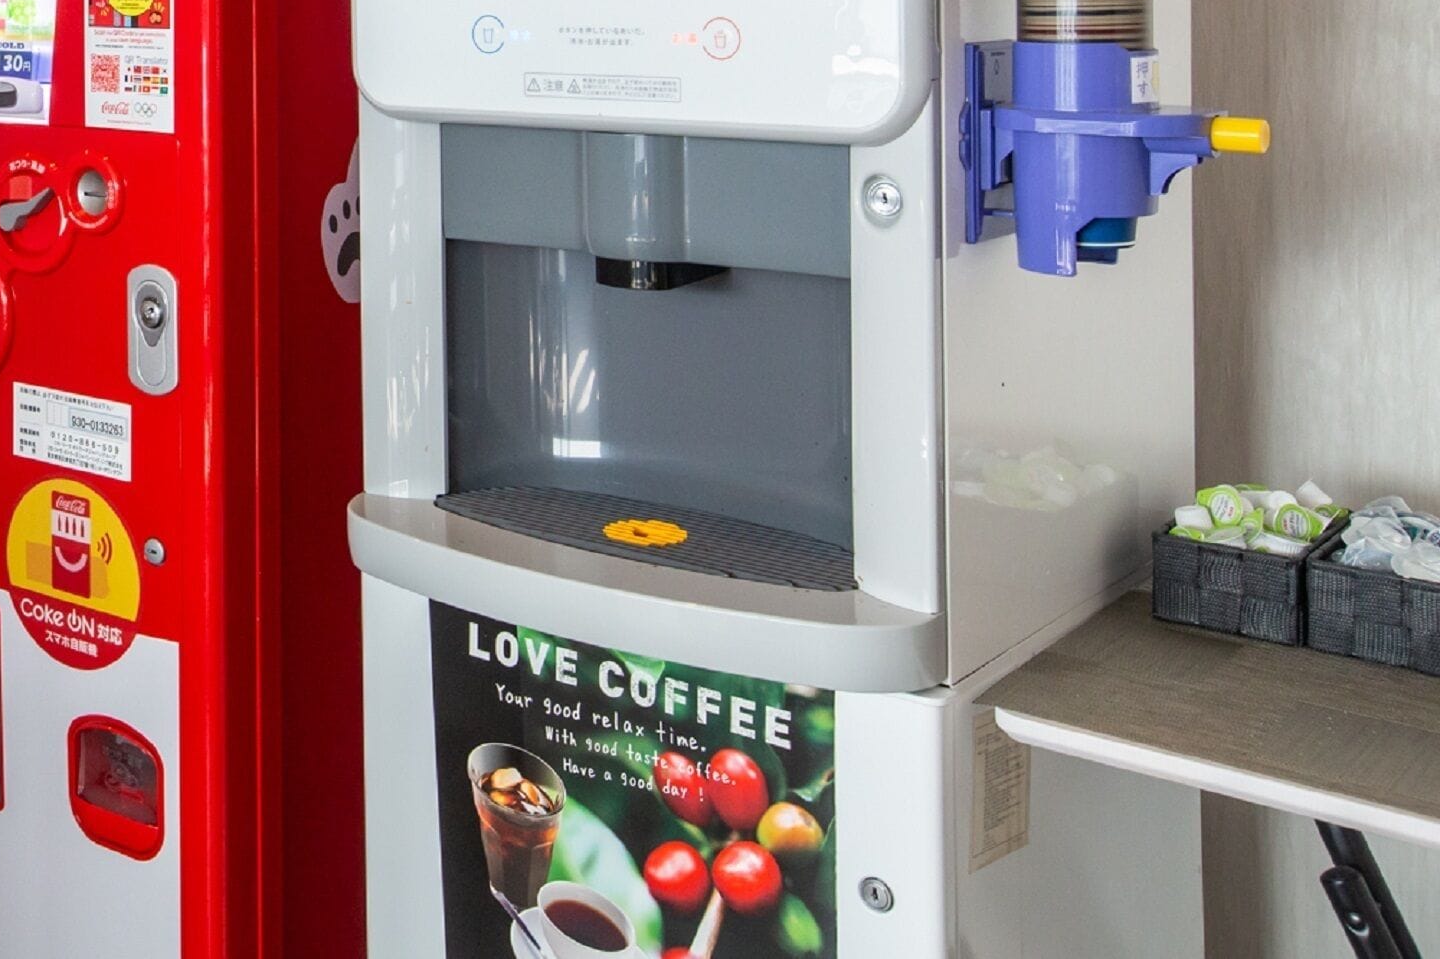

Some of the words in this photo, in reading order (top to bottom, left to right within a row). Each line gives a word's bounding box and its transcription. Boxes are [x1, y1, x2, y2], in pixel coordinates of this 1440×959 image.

[20, 598, 65, 627] Coke
[67, 609, 95, 638] ON
[97, 624, 123, 646] 対応
[45, 630, 99, 658] スマホ自販機
[468, 621, 579, 687] LOVE
[598, 659, 793, 751] COFFEE
[495, 683, 533, 710] Your
[543, 699, 581, 722] good
[591, 708, 645, 738] relax
[655, 720, 708, 753] time.
[544, 724, 577, 747] With
[586, 737, 618, 758] good
[625, 743, 669, 769] taste
[677, 756, 737, 786] coffee.
[562, 758, 596, 779] Have
[604, 770, 612, 782] a
[619, 771, 654, 791] good
[662, 777, 688, 799] day
